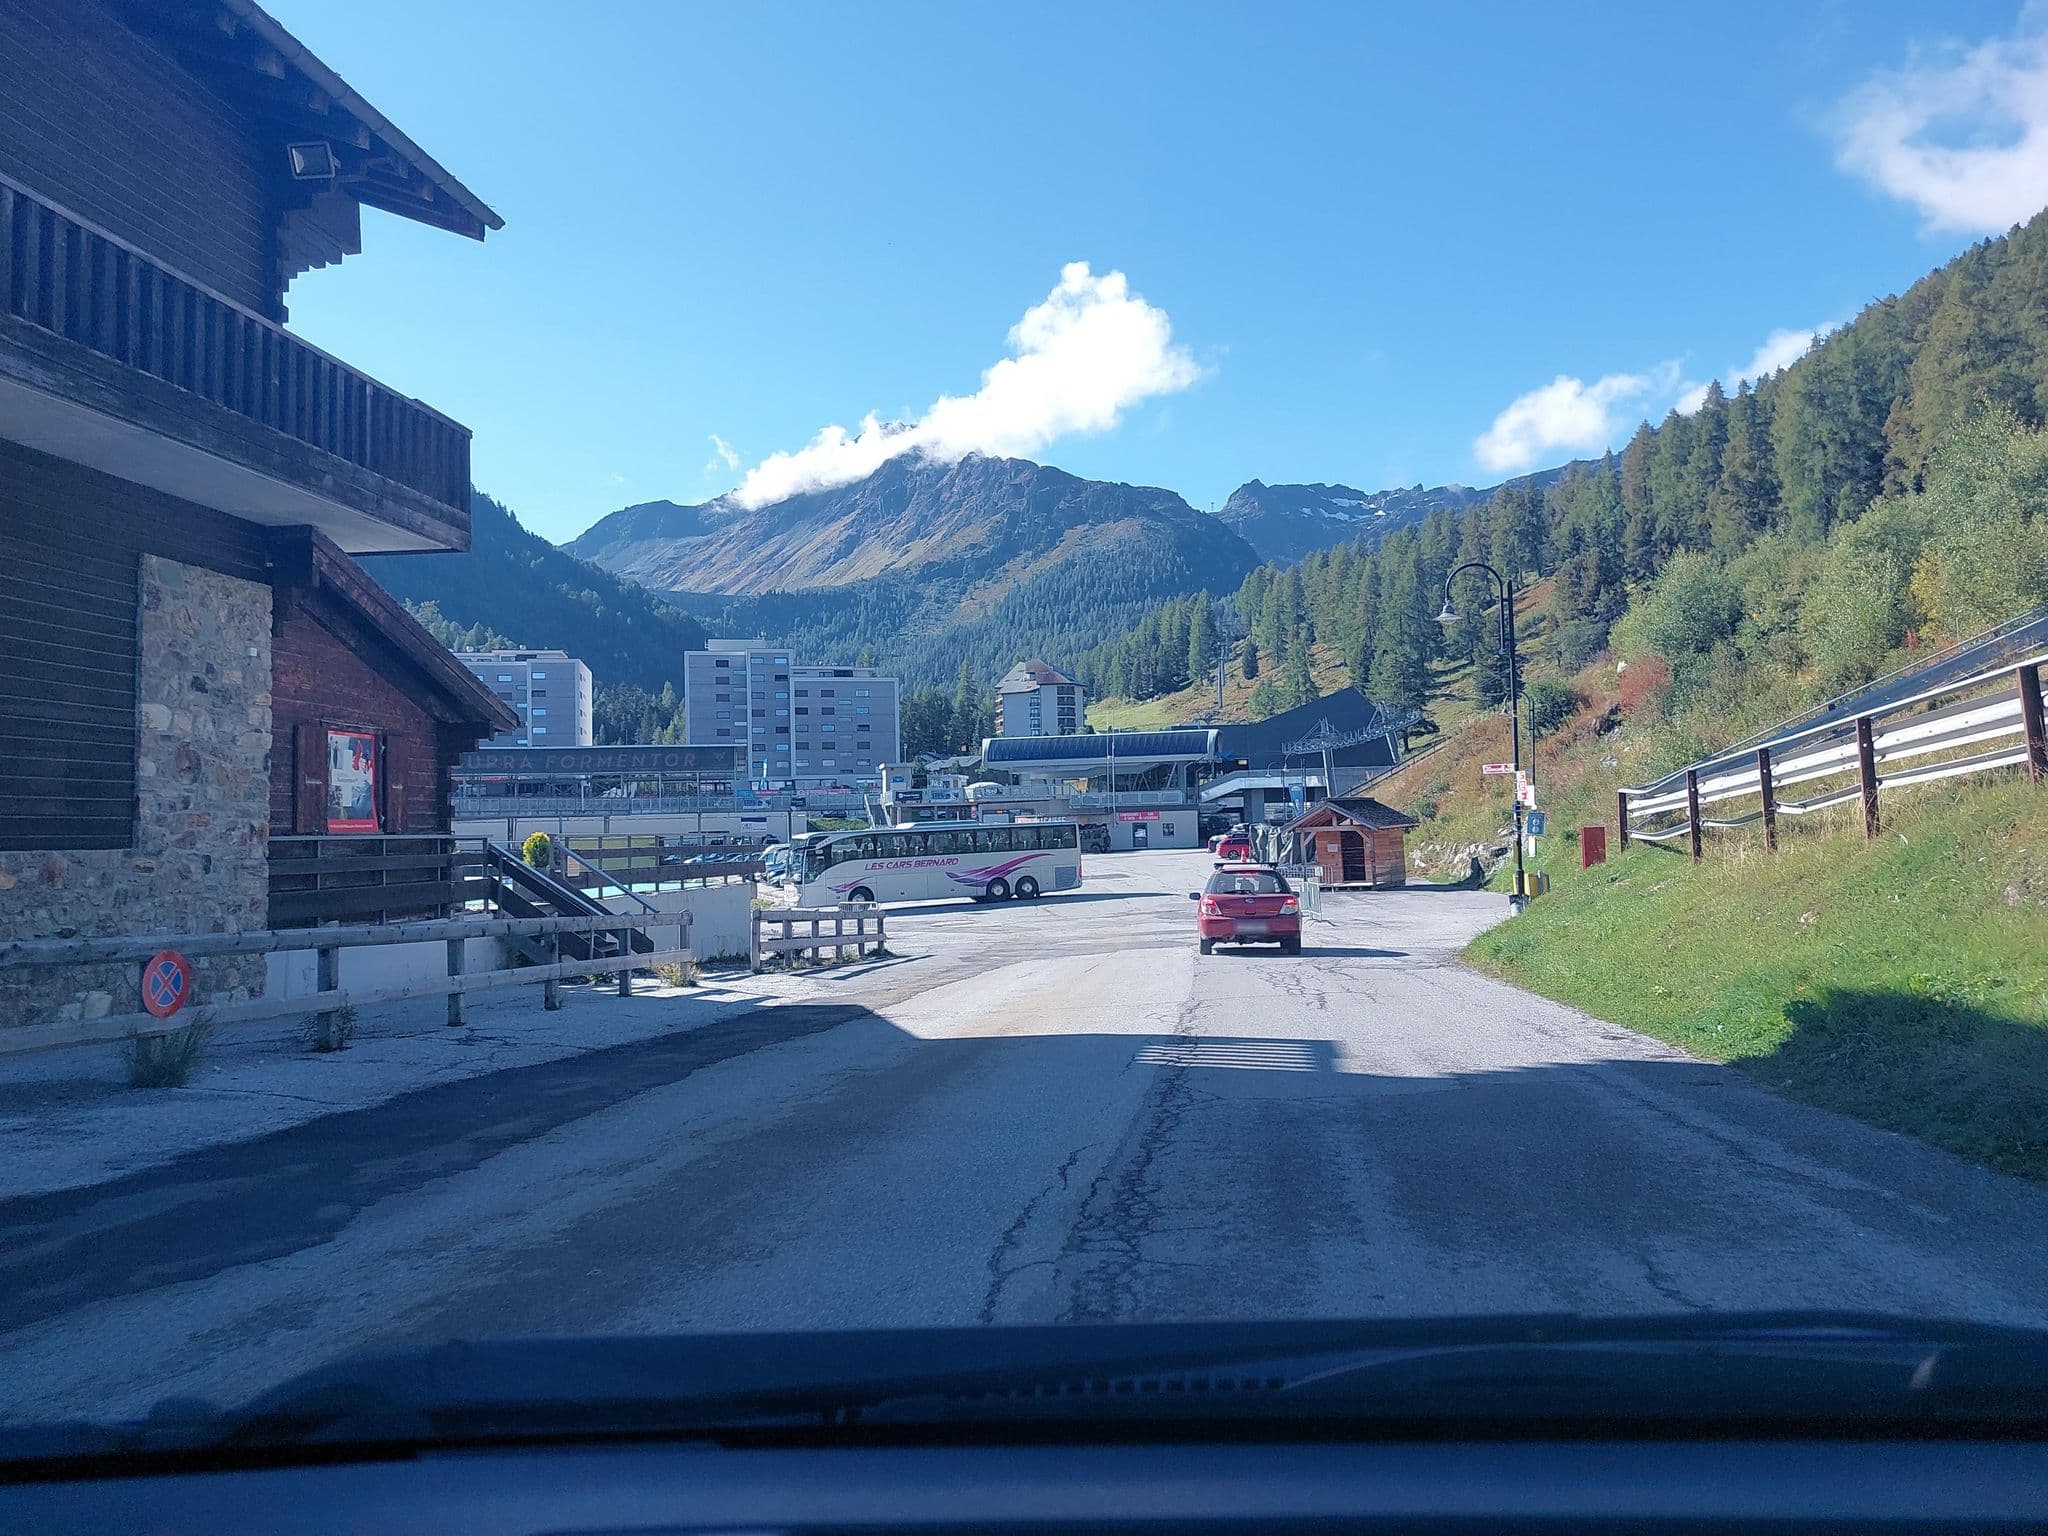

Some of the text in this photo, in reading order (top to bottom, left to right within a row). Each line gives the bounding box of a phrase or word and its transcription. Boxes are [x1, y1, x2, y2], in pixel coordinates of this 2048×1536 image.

[546, 753, 695, 769] FORMENTOR
[865, 858, 959, 870] LES CARS BERNARD
